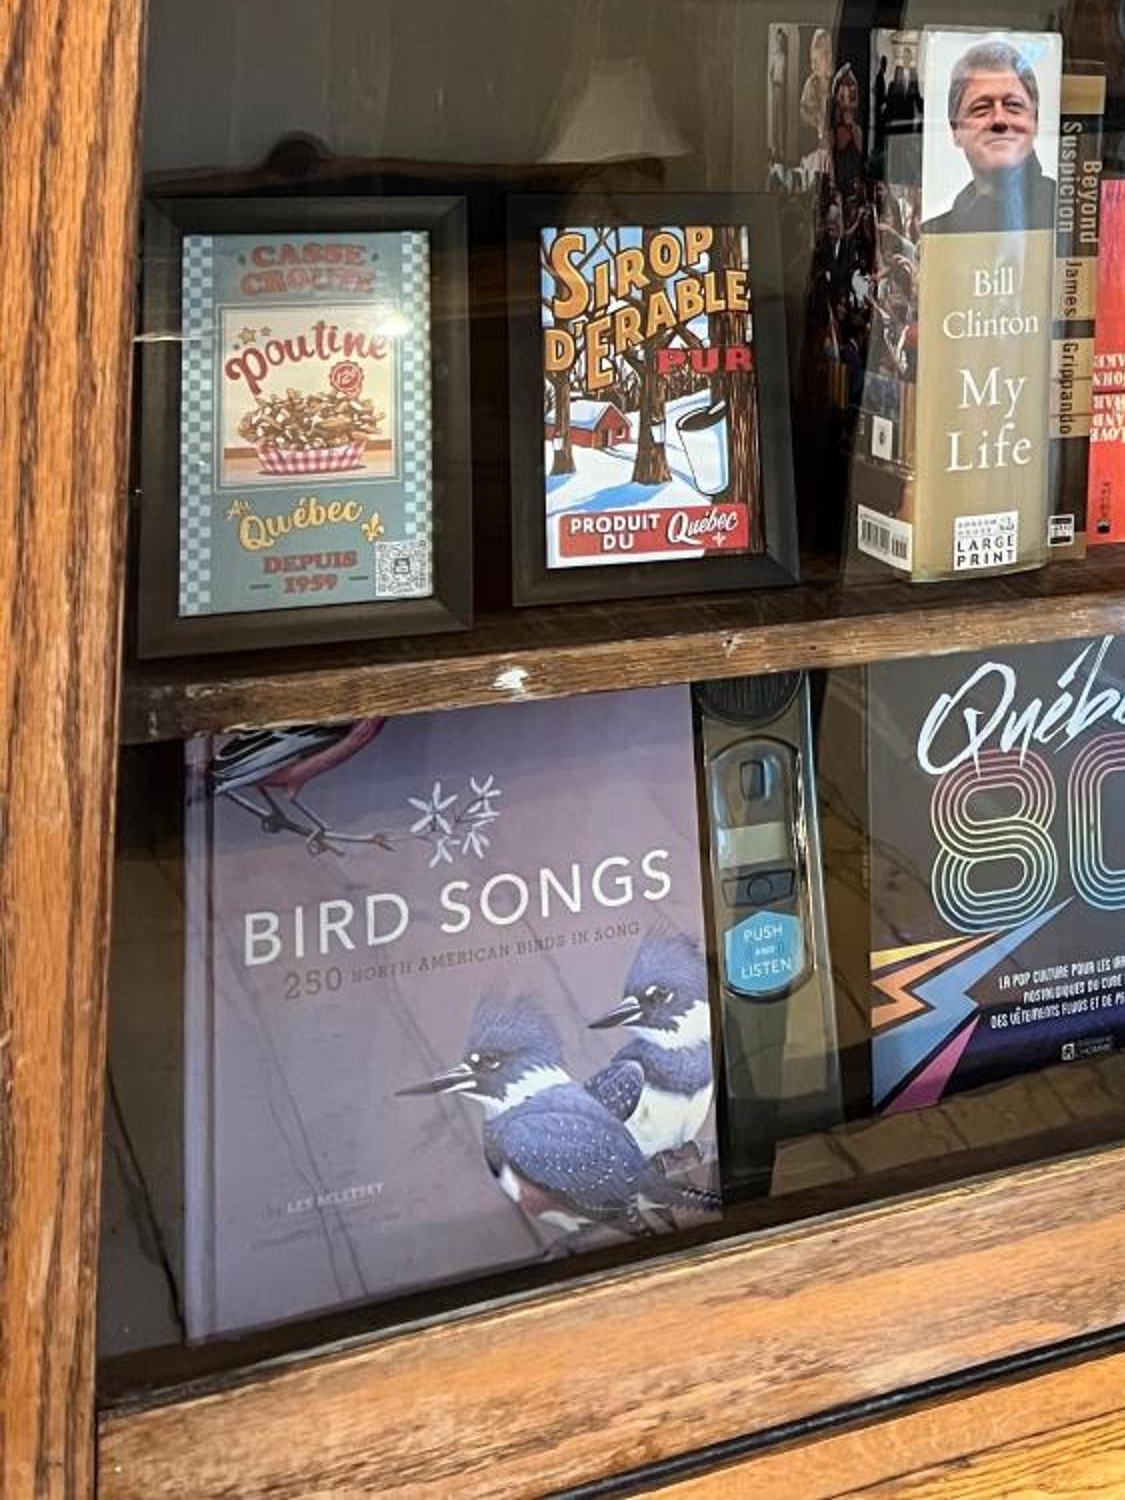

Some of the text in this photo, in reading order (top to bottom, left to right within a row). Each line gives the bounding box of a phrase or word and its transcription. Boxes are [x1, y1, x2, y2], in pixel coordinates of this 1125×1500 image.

[1058, 121, 1082, 234] Suspicion
[1080, 160, 1103, 244] Beyond
[253, 242, 366, 267] CASSE
[550, 227, 715, 320] SIROP
[974, 266, 1014, 297] Bill
[943, 309, 1039, 340] Clinton
[225, 320, 387, 395] Poutine
[656, 346, 753, 375] PUR
[1058, 260, 1083, 436] James Grippando
[959, 366, 1027, 419] My
[1092, 413, 1125, 428] AND
[945, 421, 1033, 472] Life
[240, 497, 363, 550] Québec
[570, 513, 660, 534] PRODUIT
[667, 507, 738, 545] Québec
[603, 533, 634, 550] DU
[957, 534, 1015, 554] LARGE
[264, 551, 357, 574] DEPUIS
[956, 549, 1015, 568] PRINT
[244, 849, 673, 967] BIRD SONGS
[743, 922, 784, 942] PUSH
[285, 921, 641, 1000] 250 NORTH AMERICAN BIRDS IN SONG
[741, 956, 792, 980] LISTEN
[998, 974, 1011, 990] LA
[1012, 971, 1032, 988] POP
[1033, 964, 1070, 983] CULTURE
[1071, 959, 1096, 977] POUR
